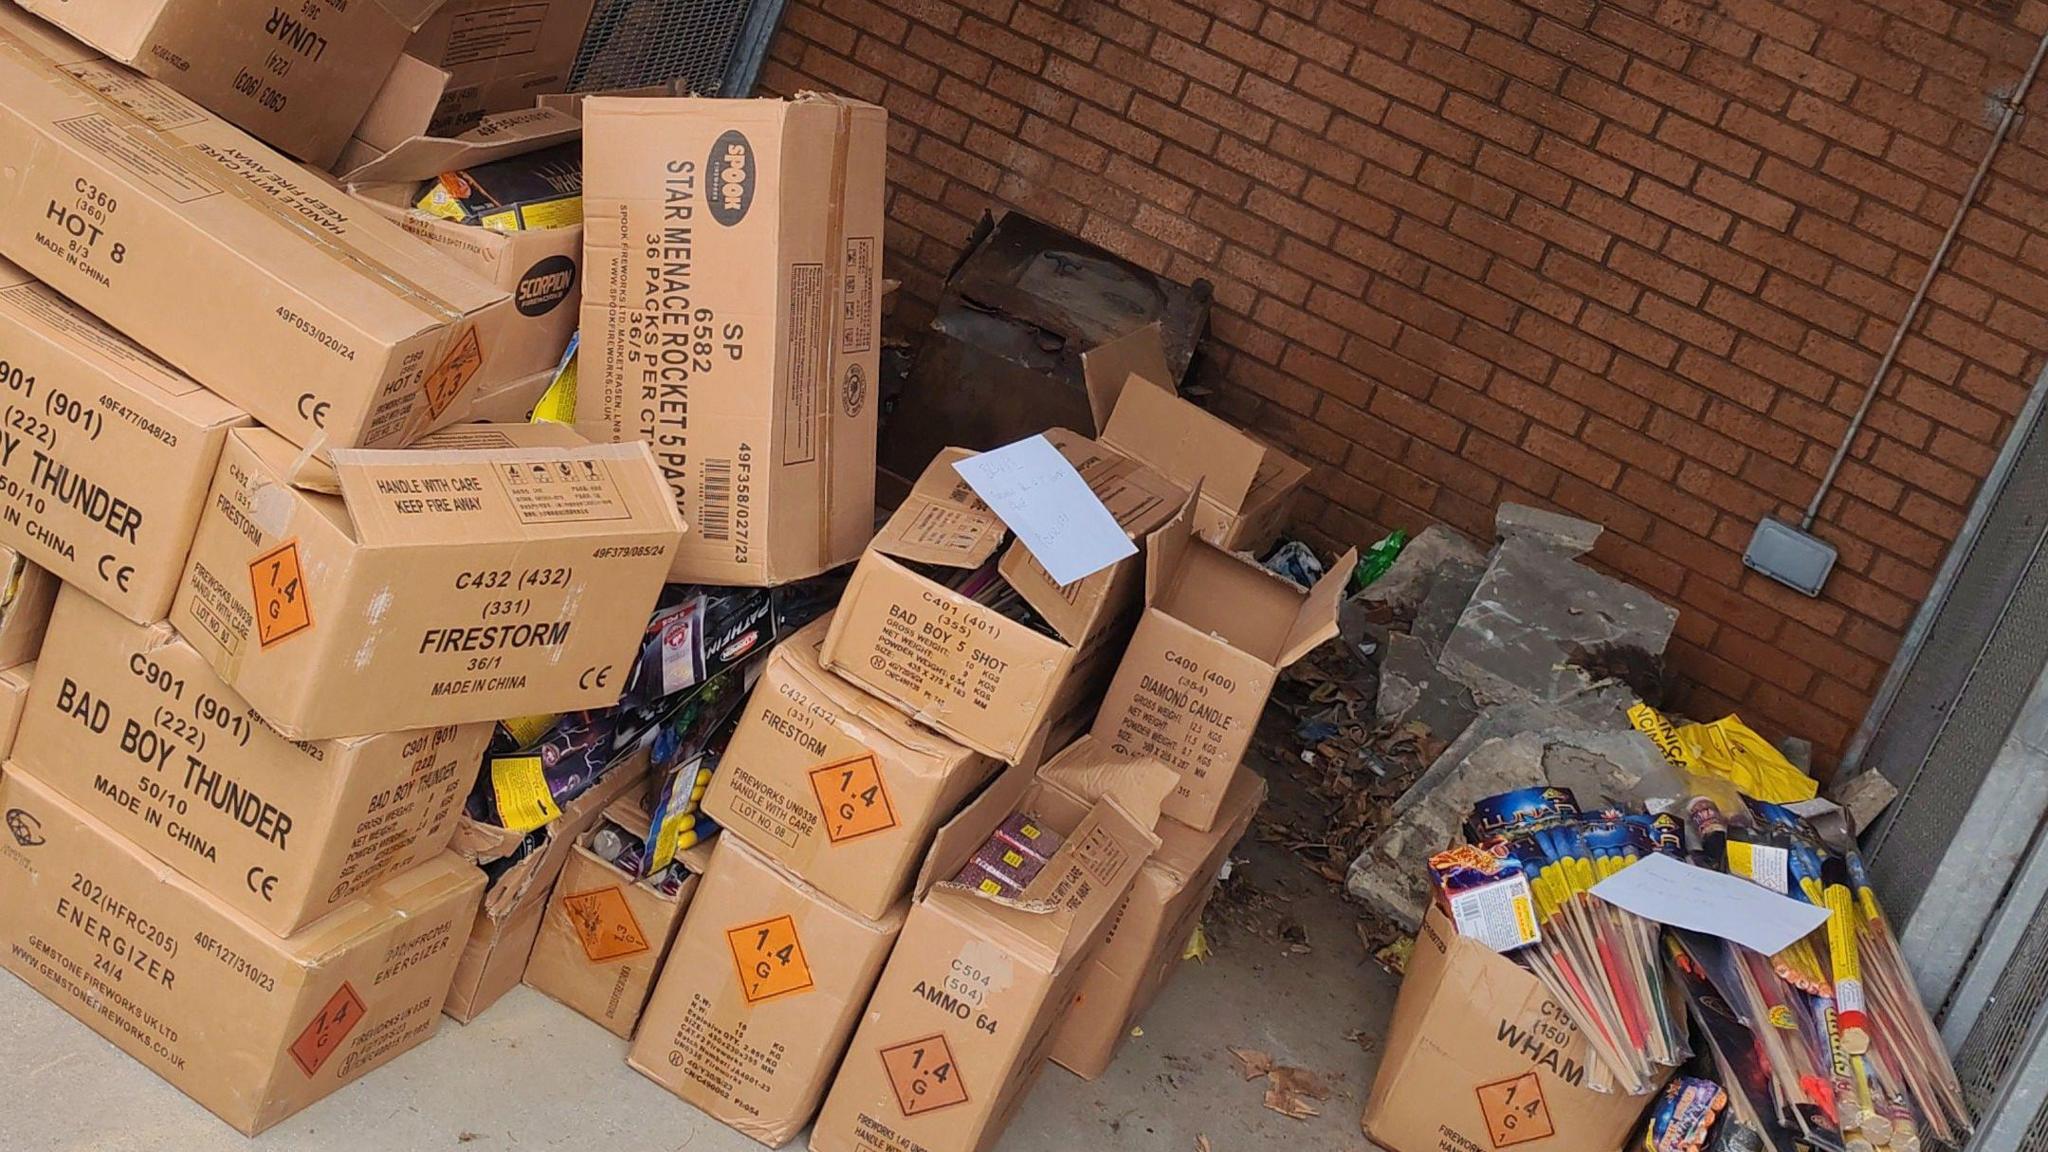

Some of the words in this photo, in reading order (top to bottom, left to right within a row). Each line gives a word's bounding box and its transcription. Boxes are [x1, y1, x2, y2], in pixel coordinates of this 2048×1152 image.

[264, 6, 328, 62] LUNAR
[232, 67, 262, 94] (903)
[264, 48, 290, 77] (224)
[259, 89, 287, 112] C903
[198, 143, 242, 171] CARE
[223, 147, 270, 180] AWAY
[76, 177, 117, 214] C360
[244, 169, 283, 205] WITH
[271, 172, 304, 201] FIRE
[665, 161, 695, 220] STAR
[720, 144, 746, 211] SPOOK
[75, 197, 106, 226] (360)
[284, 196, 346, 236] HANDLE
[306, 193, 347, 222] KEEP
[619, 204, 628, 239] SPOOK
[46, 200, 104, 247] HOT
[109, 243, 127, 264] 8
[68, 239, 90, 259] 8/3
[646, 234, 660, 259] 36
[35, 232, 66, 258] MADE
[65, 251, 78, 265] IN
[78, 261, 111, 289] CHINA
[619, 242, 628, 303] FIREWORKS
[662, 228, 691, 329] MENACE
[519, 268, 574, 299] SCORPION
[645, 268, 660, 344] PACKS
[275, 305, 355, 362] 49F053/020/24
[628, 312, 642, 361] 36/5
[693, 308, 713, 373] 6582
[723, 323, 743, 361] SP
[383, 375, 412, 397] HOT
[414, 369, 423, 383] 8
[643, 355, 659, 399] PER
[659, 332, 689, 429] ROCKET
[4, 405, 57, 451] (222)
[45, 389, 103, 441] (901)
[99, 394, 178, 448] 49F477/048/23
[659, 434, 686, 446] 5
[30, 450, 143, 545] THUNDER
[376, 479, 420, 494] HANDLE
[422, 478, 450, 493] WITH
[452, 477, 482, 492] CARE
[735, 443, 751, 564] 49F358/027/23
[216, 494, 263, 548] FIRESTORM
[394, 499, 423, 515] KEEP
[427, 498, 452, 513] FIRE
[454, 497, 482, 512] AWAY
[4, 505, 21, 527] IN
[26, 520, 75, 562] CHINA
[191, 576, 215, 605] HANDLE
[215, 599, 232, 618] WITH
[194, 561, 231, 603] FIREWORKS
[271, 561, 298, 603] 1.4
[455, 571, 511, 590] C432
[517, 567, 573, 591] (432)
[195, 604, 209, 620] LOT
[269, 599, 281, 619] G
[482, 599, 531, 619] (331)
[922, 591, 959, 616] C401
[963, 611, 1001, 640] (401)
[937, 614, 972, 638] (355)
[265, 625, 272, 638] 1
[419, 621, 571, 654] FIRESTORM
[888, 603, 918, 626] BAD
[923, 619, 952, 644] BOY
[956, 641, 967, 653] 5
[970, 647, 1008, 674] SHOT
[467, 656, 502, 671] 36/1
[878, 635, 914, 658] POWDER
[973, 687, 992, 701] KGS
[882, 626, 901, 641] NET
[977, 679, 997, 693] KGS
[886, 618, 915, 639] GROSS
[965, 660, 975, 671] 10
[982, 669, 1001, 684] KGS
[431, 682, 469, 696] MADE
[471, 681, 485, 693] IN
[487, 675, 526, 691] CHINA
[1164, 650, 1198, 673] C400
[1202, 669, 1236, 694] (400)
[129, 652, 185, 701] C901
[194, 693, 251, 747] (901)
[779, 682, 808, 708] C432
[807, 702, 837, 727] (432)
[787, 706, 815, 730] (331)
[1128, 705, 1142, 718] NET
[1140, 675, 1188, 708] DIAMOND
[1189, 700, 1233, 731] CANDLE
[154, 706, 206, 753] (222)
[761, 708, 828, 758] FIRESTORM
[1207, 731, 1223, 744] KGS
[56, 677, 110, 735] BAD
[120, 718, 176, 773] BOY
[183, 754, 292, 851] THUNDER
[138, 776, 187, 816] 50/10
[368, 791, 390, 814] BAD
[393, 779, 416, 803] BOY
[733, 767, 785, 806] FIREWORKS
[785, 800, 819, 826] UN0336
[840, 770, 878, 808] 1.4
[93, 774, 141, 815] MADE
[144, 806, 162, 828] IN
[167, 822, 217, 864] CHINA
[730, 779, 766, 808] HANDLE
[764, 801, 788, 821] WITH
[788, 814, 814, 838] CARE
[738, 802, 757, 819] LOT
[757, 814, 773, 831] NO.
[839, 803, 855, 821] G
[836, 824, 843, 836] 1
[71, 872, 179, 960] 202(HFRC205)
[56, 898, 176, 990] ENERGIZER
[194, 931, 275, 993] 40F127/310/23
[374, 936, 450, 986] ENERGIZER
[755, 928, 794, 966] 1.4
[93, 953, 123, 982] 24/4
[755, 961, 772, 979] G
[951, 959, 991, 987] C504
[28, 935, 83, 981] GEMSTONE
[83, 973, 143, 1020] FIREWORKS
[143, 1012, 157, 1030] UK
[158, 1024, 179, 1043] LTD
[751, 983, 759, 996] 1
[912, 980, 971, 1020] AMMO
[976, 1014, 998, 1035] 64
[943, 975, 983, 1005] (504)
[1532, 1019, 1571, 1049] (150)
[912, 1048, 951, 1084] 1.4
[1497, 1019, 1585, 1088] WHAM
[909, 1099, 915, 1110] 1
[911, 1079, 928, 1096] G
[1505, 1085, 1541, 1119] 1.4
[854, 1126, 886, 1149] HANDLE
[857, 1112, 896, 1140] FIREWORKS
[1499, 1132, 1506, 1142] 1
[1503, 1113, 1518, 1131] G
